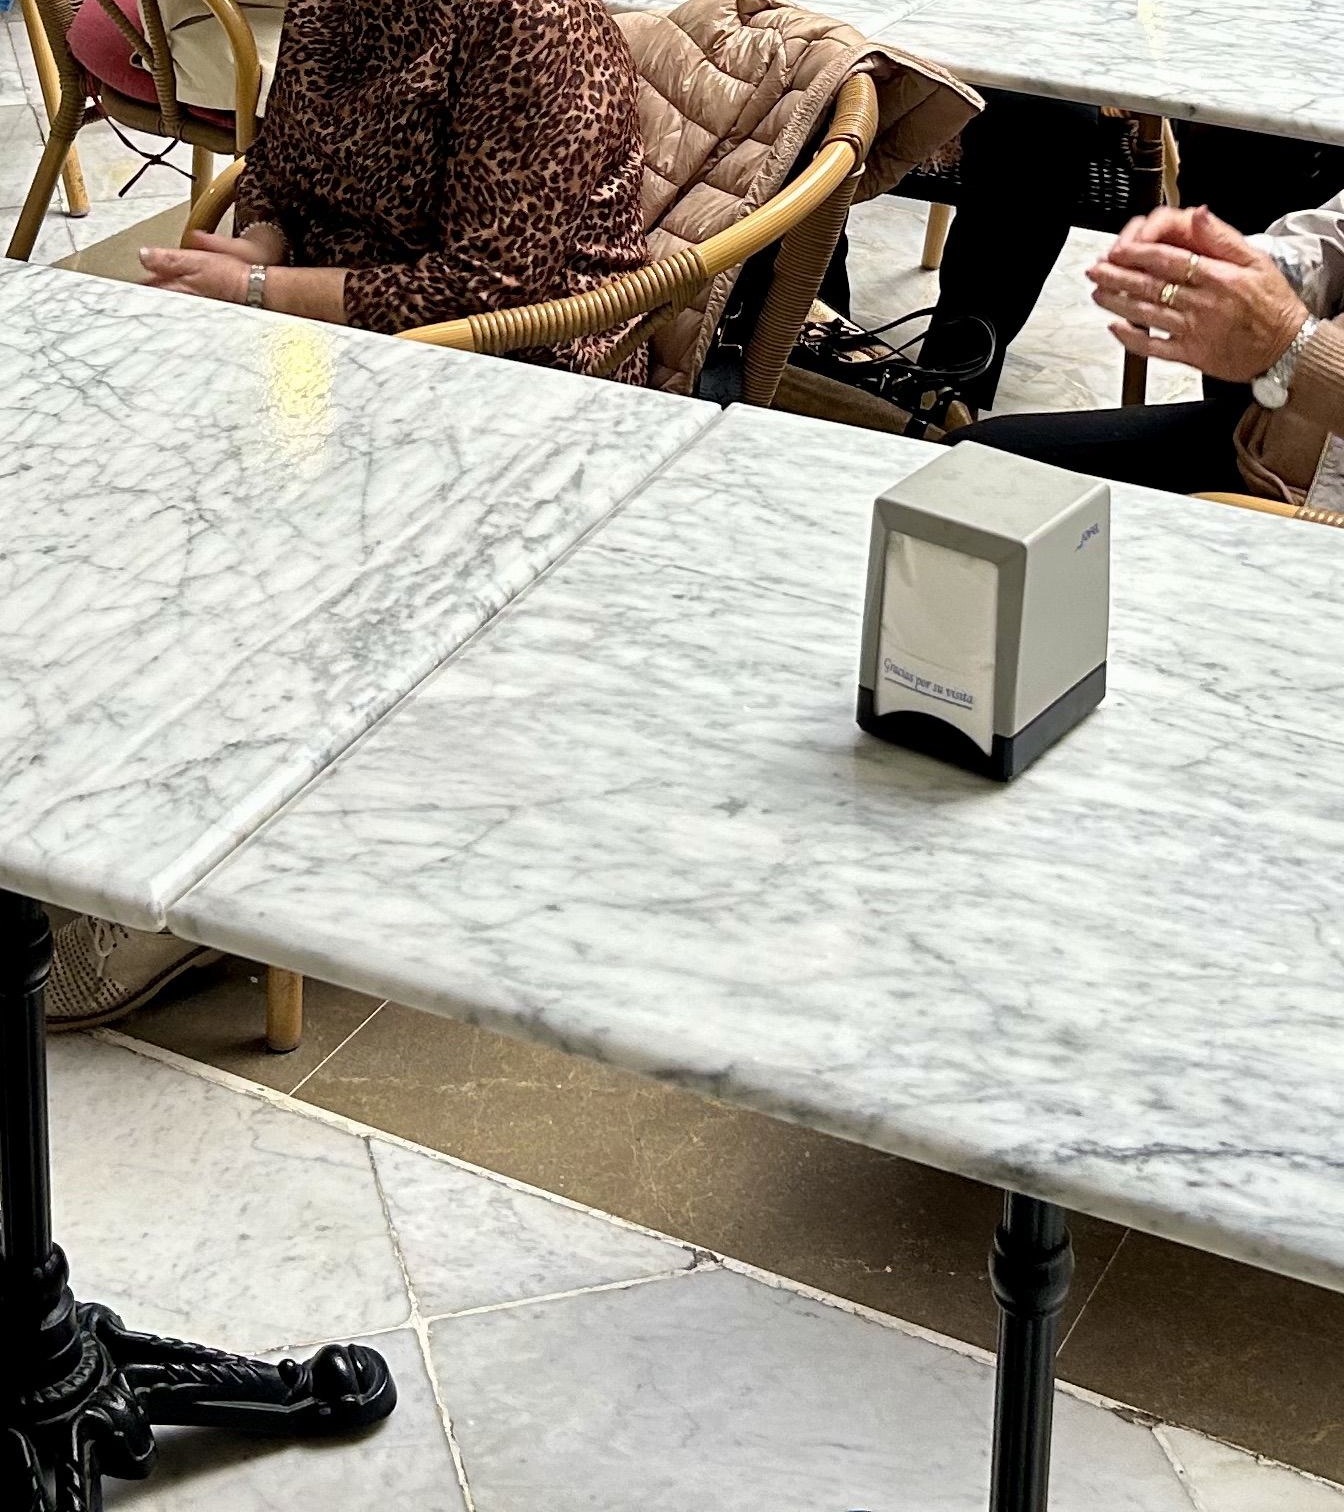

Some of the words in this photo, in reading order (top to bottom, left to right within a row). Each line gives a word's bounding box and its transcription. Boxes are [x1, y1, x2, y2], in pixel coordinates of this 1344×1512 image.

[883, 657, 914, 683] Gracias
[915, 676, 932, 689] por
[933, 683, 944, 695] su
[945, 687, 974, 705] visita
